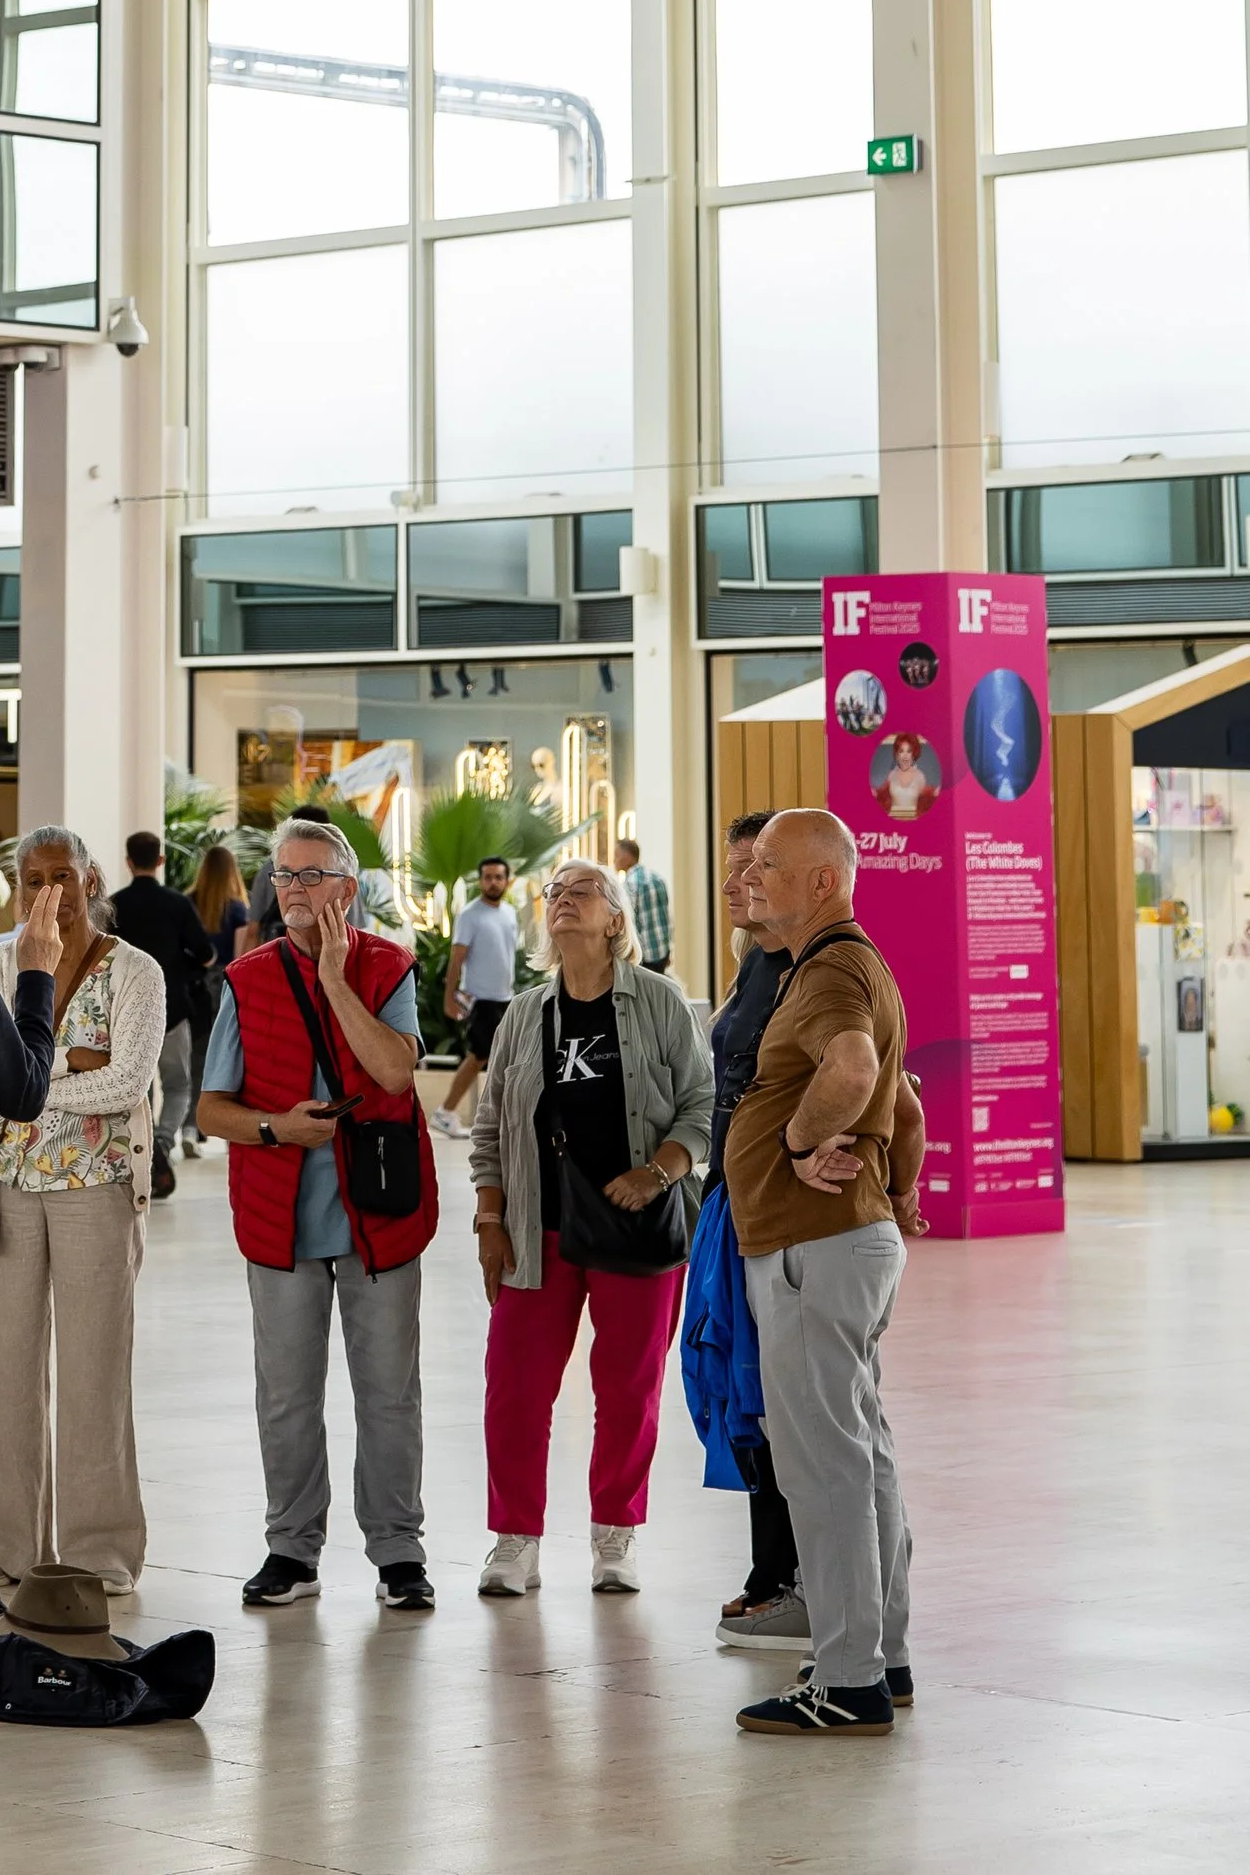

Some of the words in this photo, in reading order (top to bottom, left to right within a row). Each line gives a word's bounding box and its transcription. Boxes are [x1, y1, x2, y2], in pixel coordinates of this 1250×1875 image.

[832, 590, 871, 636] IF
[958, 588, 993, 634] IF
[878, 831, 909, 853] July
[965, 841, 982, 854] Les
[982, 840, 1024, 854] Colombes
[857, 853, 909, 874] Amazing
[910, 852, 943, 874] Days
[966, 855, 987, 872] (The
[988, 856, 1013, 870] White
[1014, 855, 1043, 872] Doves)
[38, 1676, 72, 1686] Barbour
